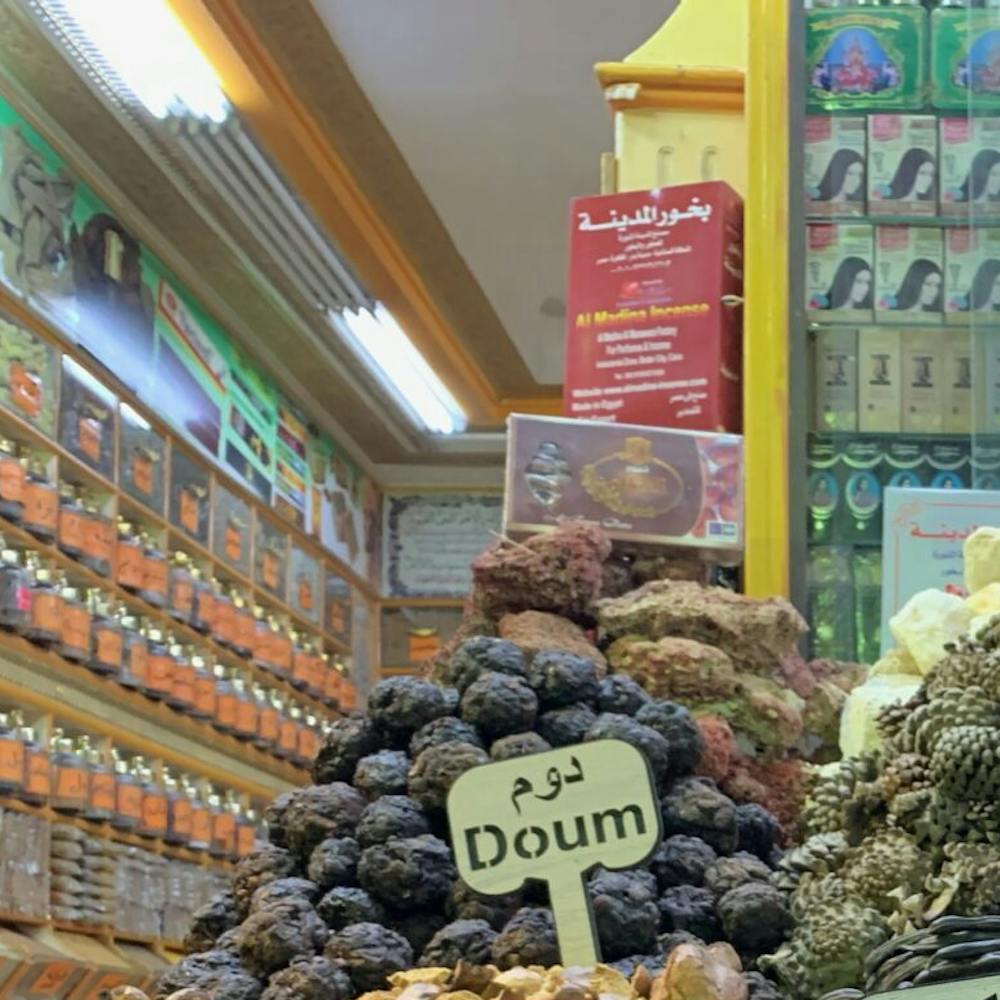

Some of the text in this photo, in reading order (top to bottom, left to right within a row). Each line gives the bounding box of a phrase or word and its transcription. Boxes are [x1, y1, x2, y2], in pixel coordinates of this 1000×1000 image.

[578, 197, 712, 231] بخور المدينة
[511, 756, 584, 816] دوم
[464, 804, 647, 871] Doum
